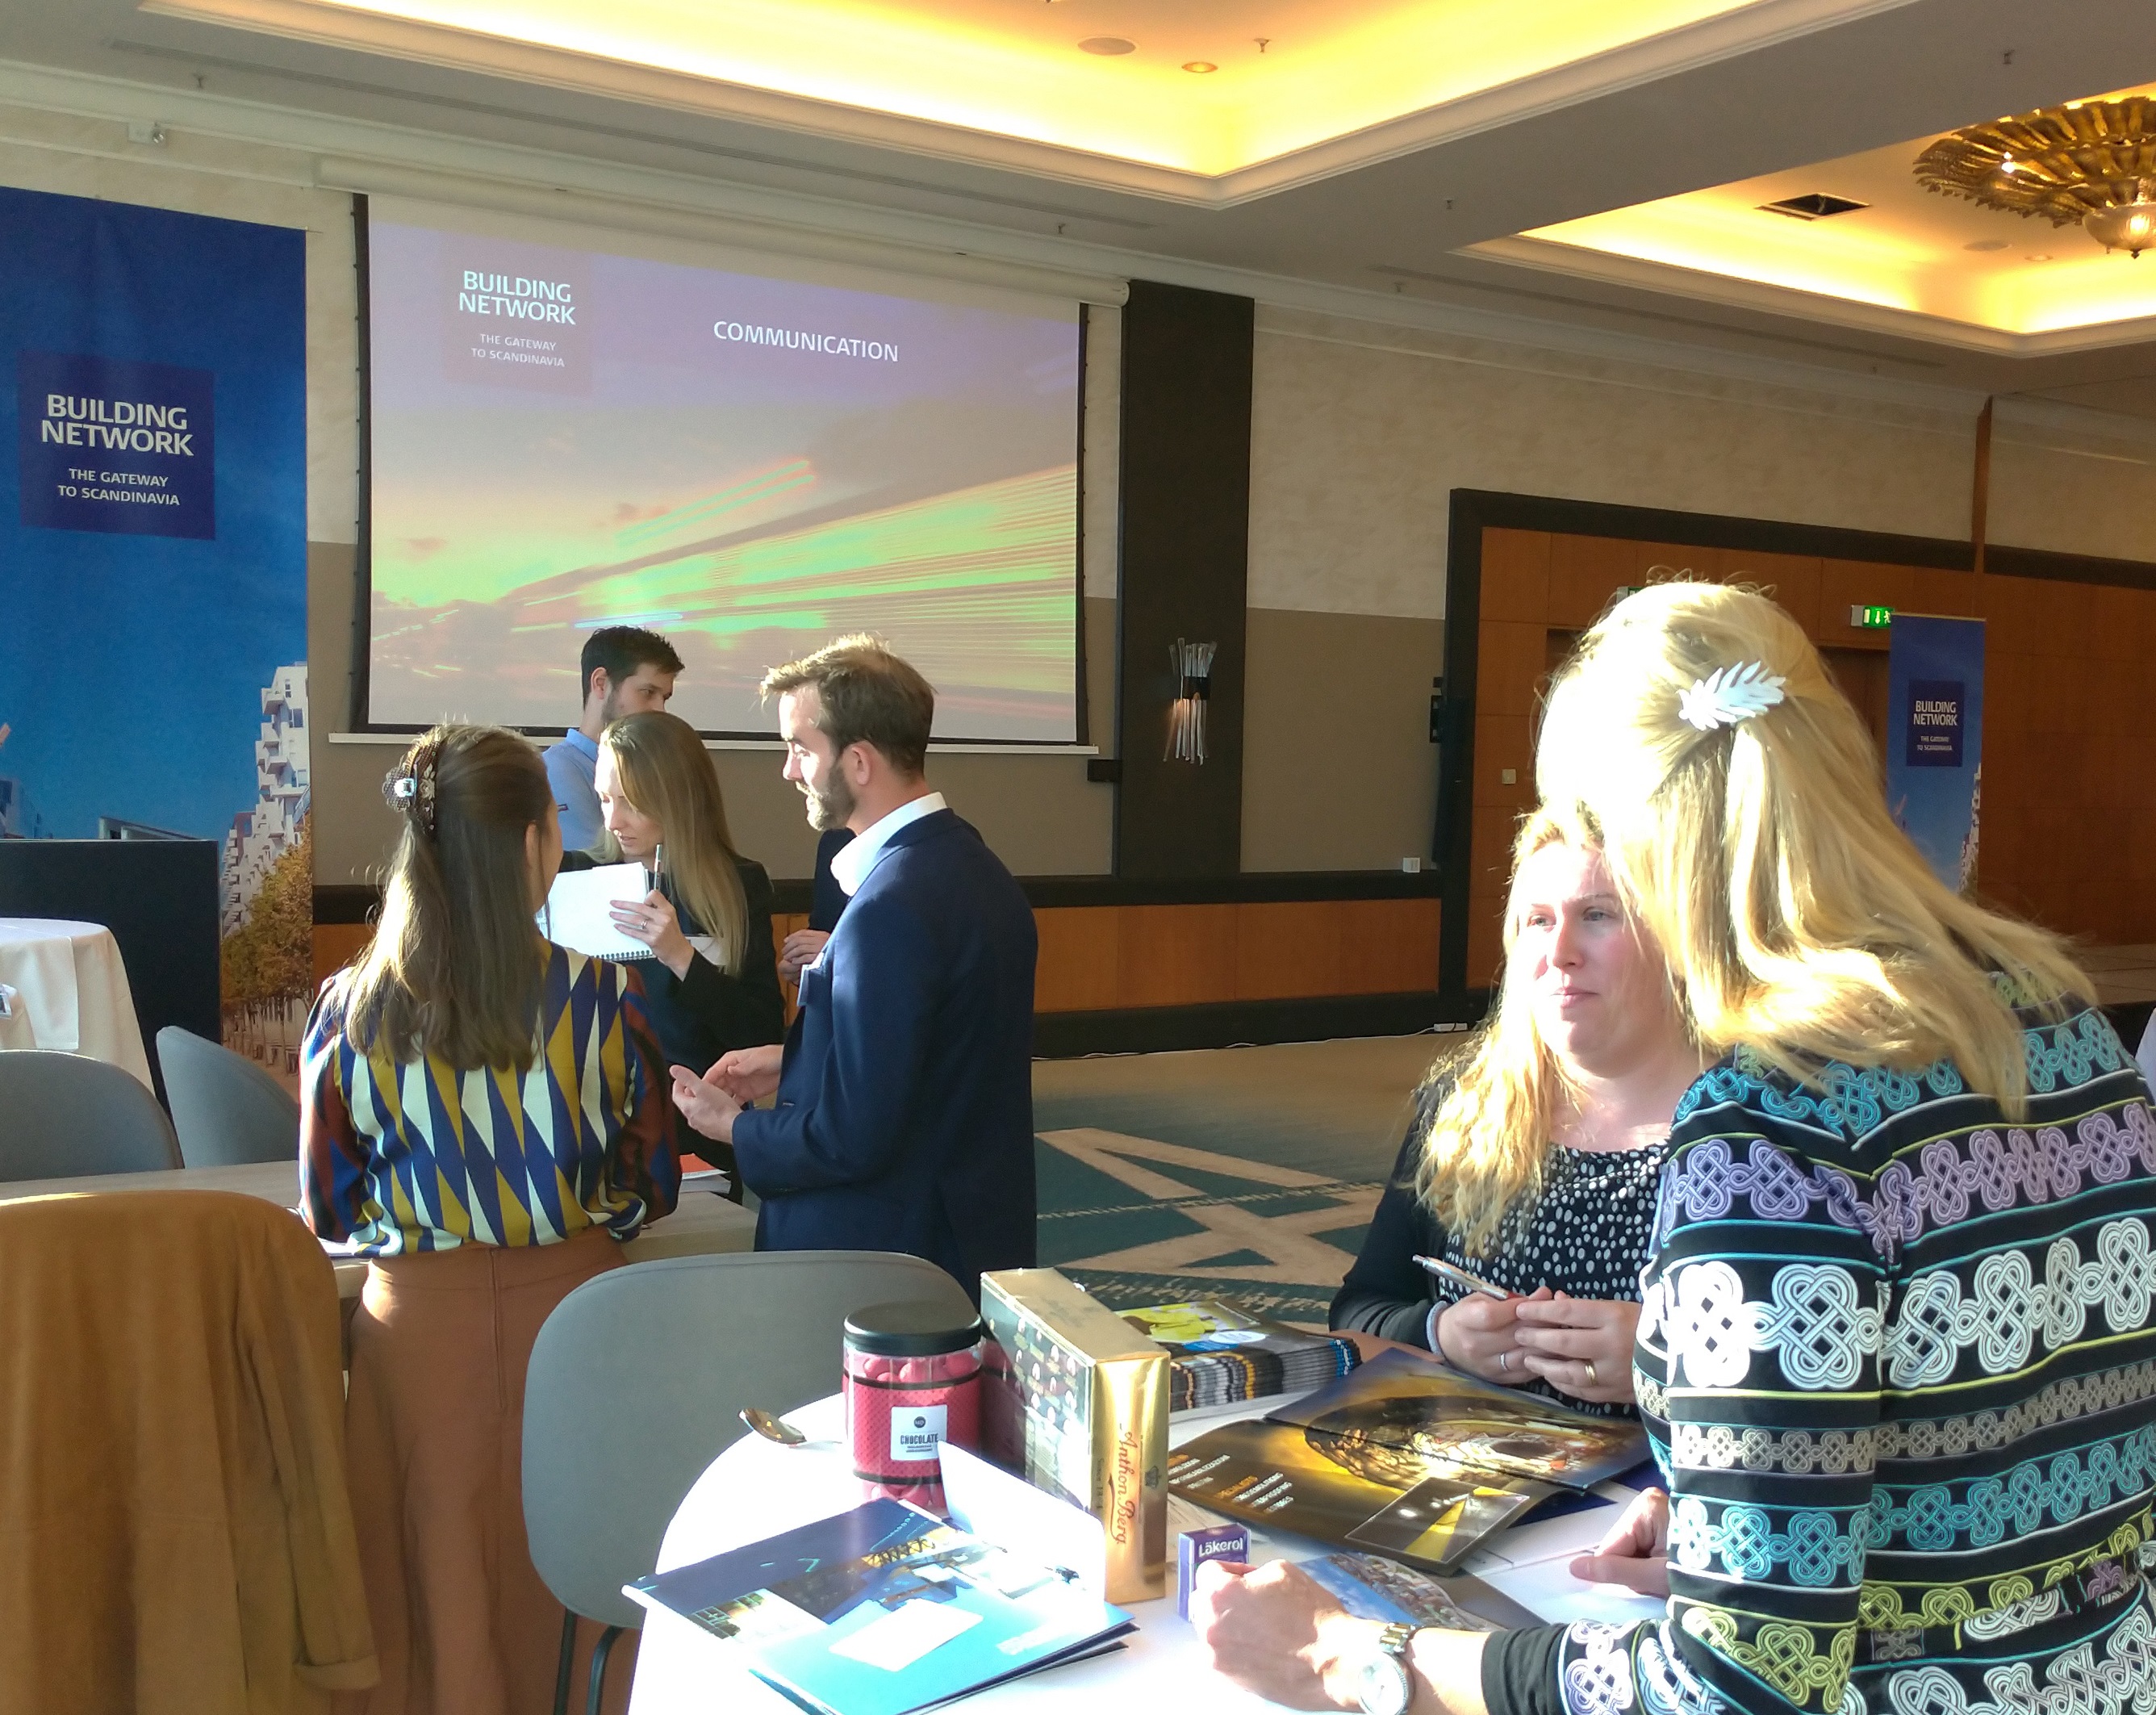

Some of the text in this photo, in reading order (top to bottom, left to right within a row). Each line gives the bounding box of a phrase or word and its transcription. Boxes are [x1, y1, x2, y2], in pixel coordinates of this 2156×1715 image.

[464, 270, 571, 303] BUILDING
[459, 292, 576, 325] NETWORK
[479, 333, 557, 351] THE GATEWAY
[713, 320, 898, 362] COMMUNICATION
[471, 348, 566, 367] TO SCANDINAVIA
[48, 394, 187, 430] BUILDING
[41, 420, 194, 456] NETWORK
[69, 467, 169, 487] THE GATEWAY
[57, 485, 180, 505] TO SCANDINAVIA
[1916, 700, 1957, 713] BUILDING
[1913, 713, 1958, 726] NETWORK
[900, 1433, 938, 1445] CHOCOLATE
[1116, 1430, 1139, 1545] Anthon Berg
[1198, 1537, 1243, 1558] Läkerol
